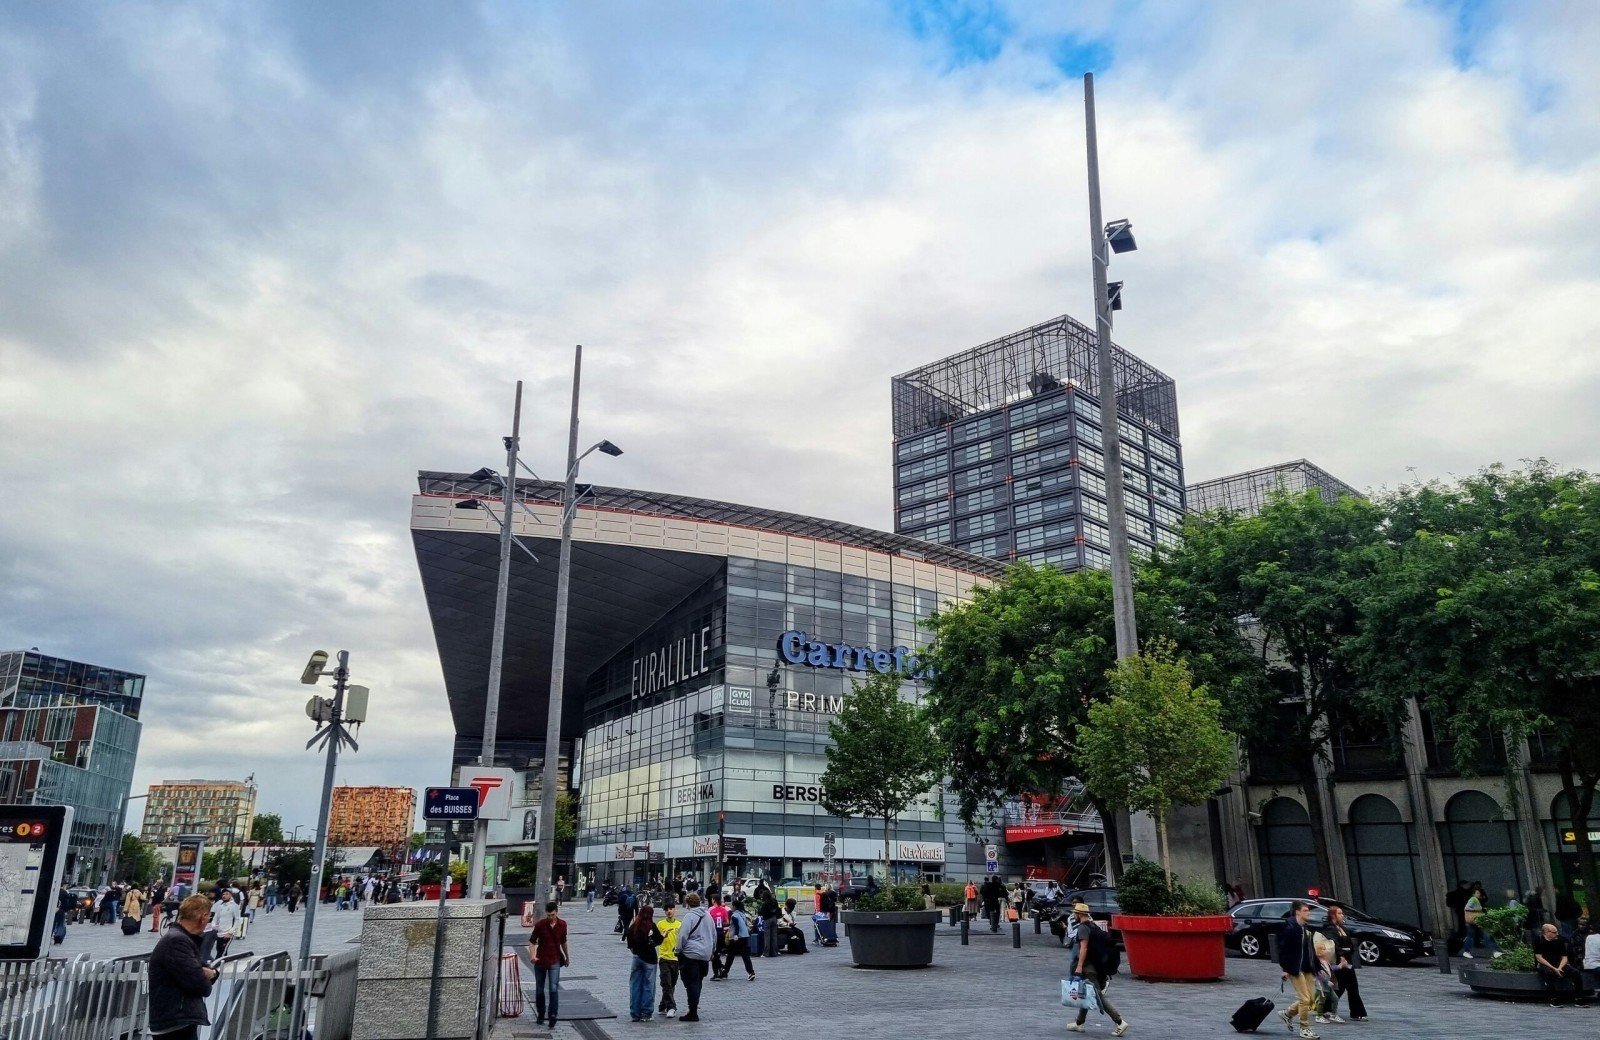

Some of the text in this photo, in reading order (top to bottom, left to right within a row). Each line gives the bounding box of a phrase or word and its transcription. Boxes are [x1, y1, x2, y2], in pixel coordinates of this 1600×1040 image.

[631, 626, 710, 700] EURALILLE
[779, 630, 935, 679] Carrefo
[731, 698, 750, 707] CLUB
[732, 690, 750, 699] GYM
[787, 691, 858, 714] PRIM
[677, 784, 714, 804] BERSHKA
[430, 806, 472, 814] des BUISSES
